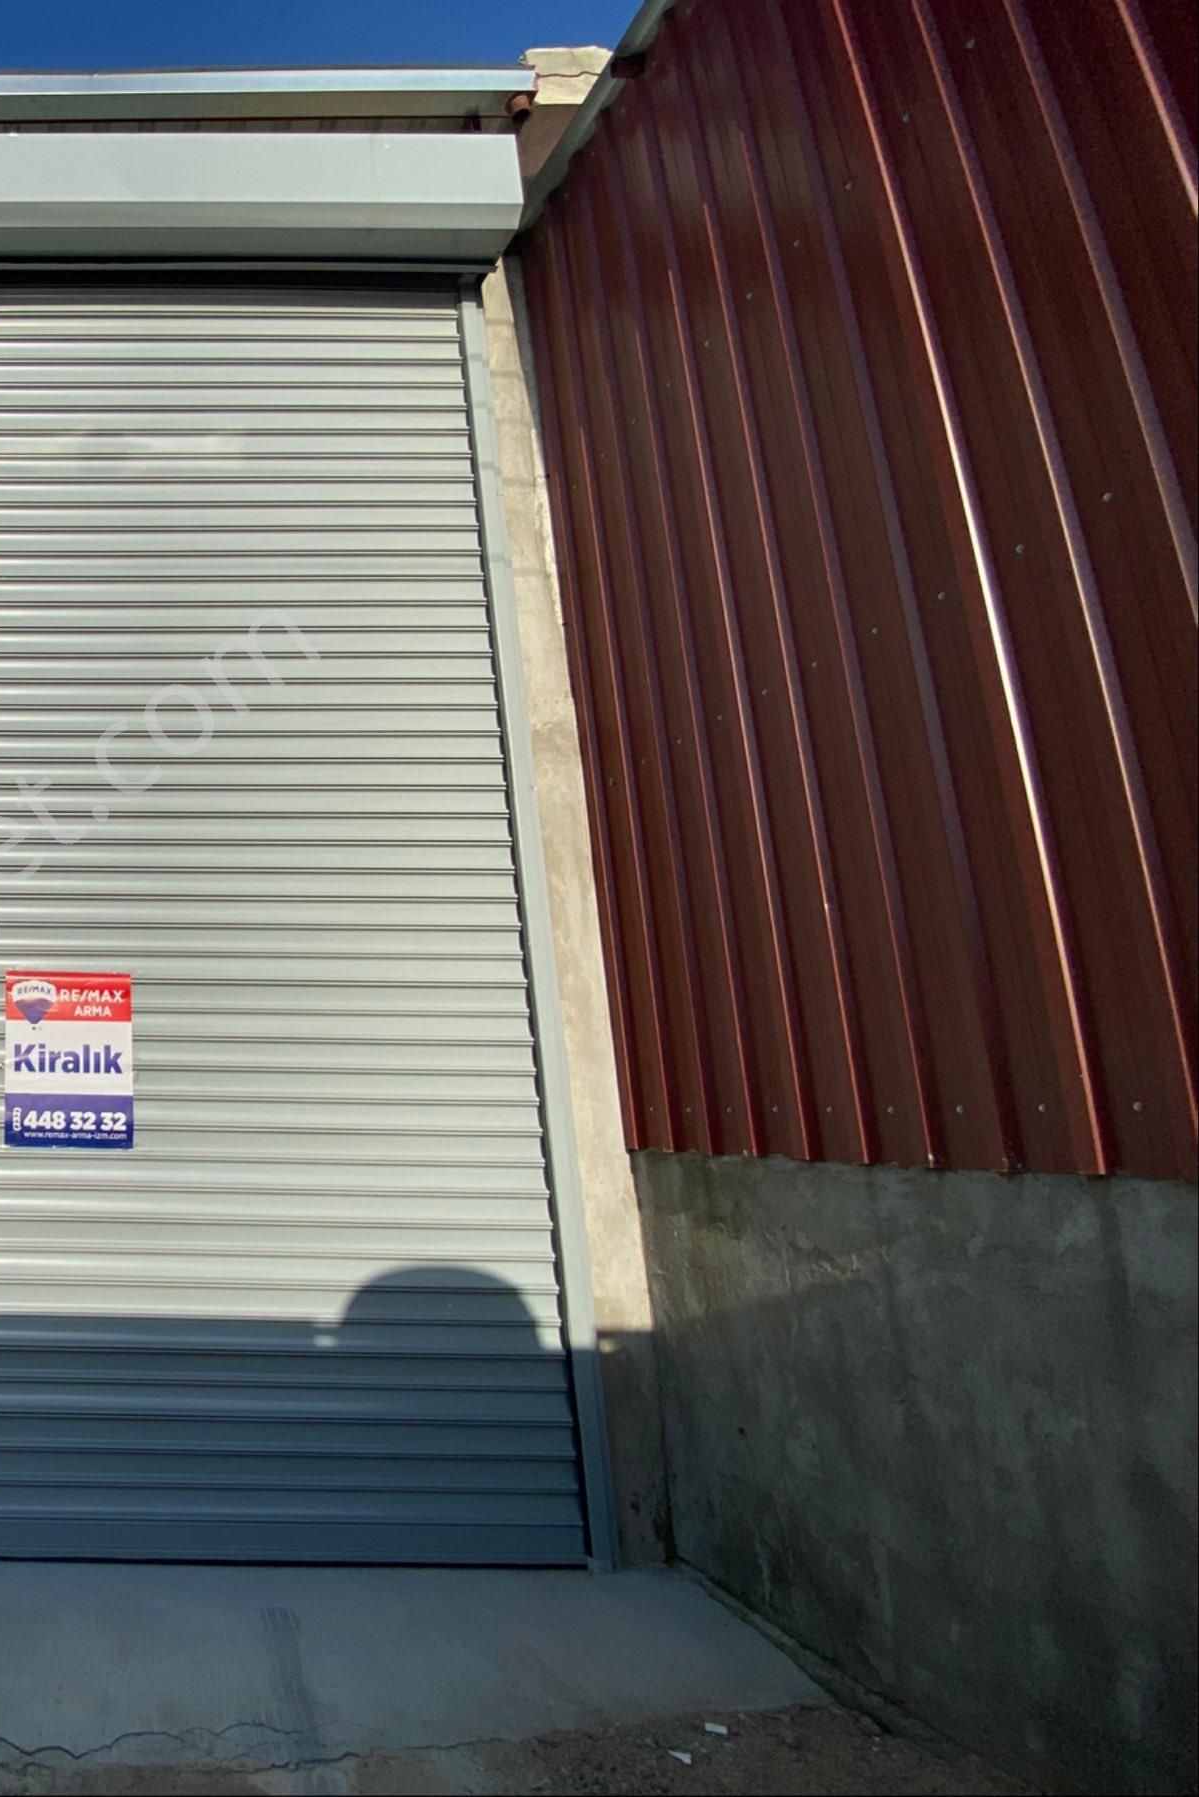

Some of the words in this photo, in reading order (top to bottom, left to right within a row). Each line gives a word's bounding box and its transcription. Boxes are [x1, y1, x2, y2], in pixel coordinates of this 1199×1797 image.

[17, 985, 51, 995] RE/MAX
[59, 988, 124, 1003] RE/MAX
[74, 1005, 112, 1017] ARMA
[13, 1043, 123, 1074] Kiralık
[23, 1110, 66, 1129] 448
[69, 1111, 96, 1131] 32
[100, 1111, 127, 1131] 32
